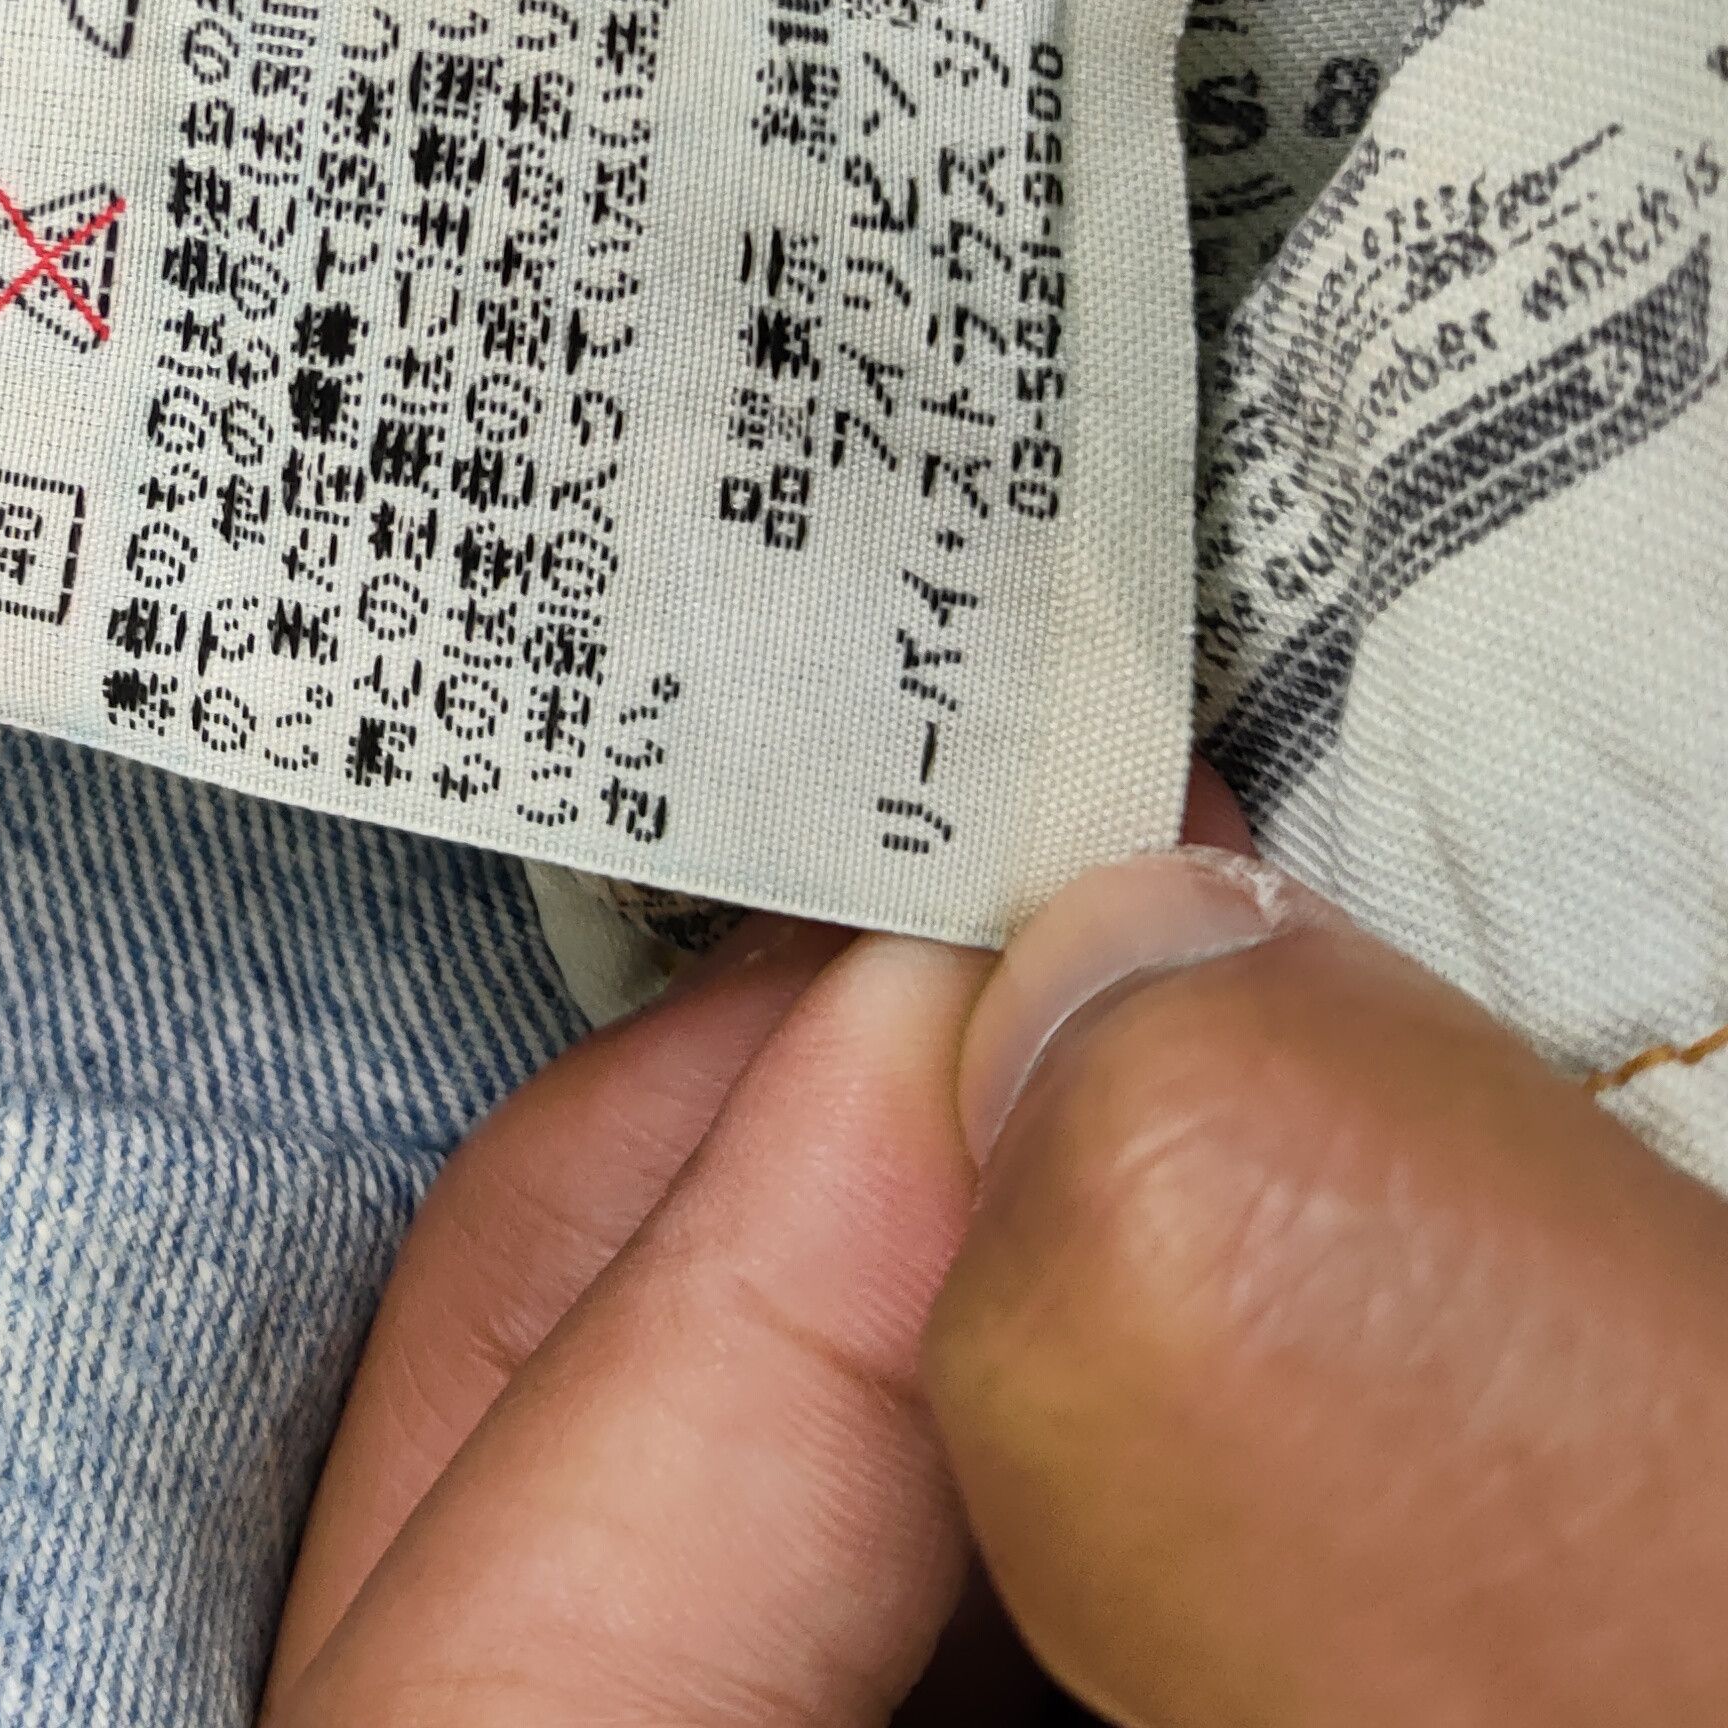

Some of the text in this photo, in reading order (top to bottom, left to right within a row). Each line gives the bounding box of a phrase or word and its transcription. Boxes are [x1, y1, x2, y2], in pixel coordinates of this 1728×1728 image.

[717, 224, 827, 552] 品質表示
[1007, 40, 1067, 522] 03-5421-9500
[598, 671, 681, 844] さい。
